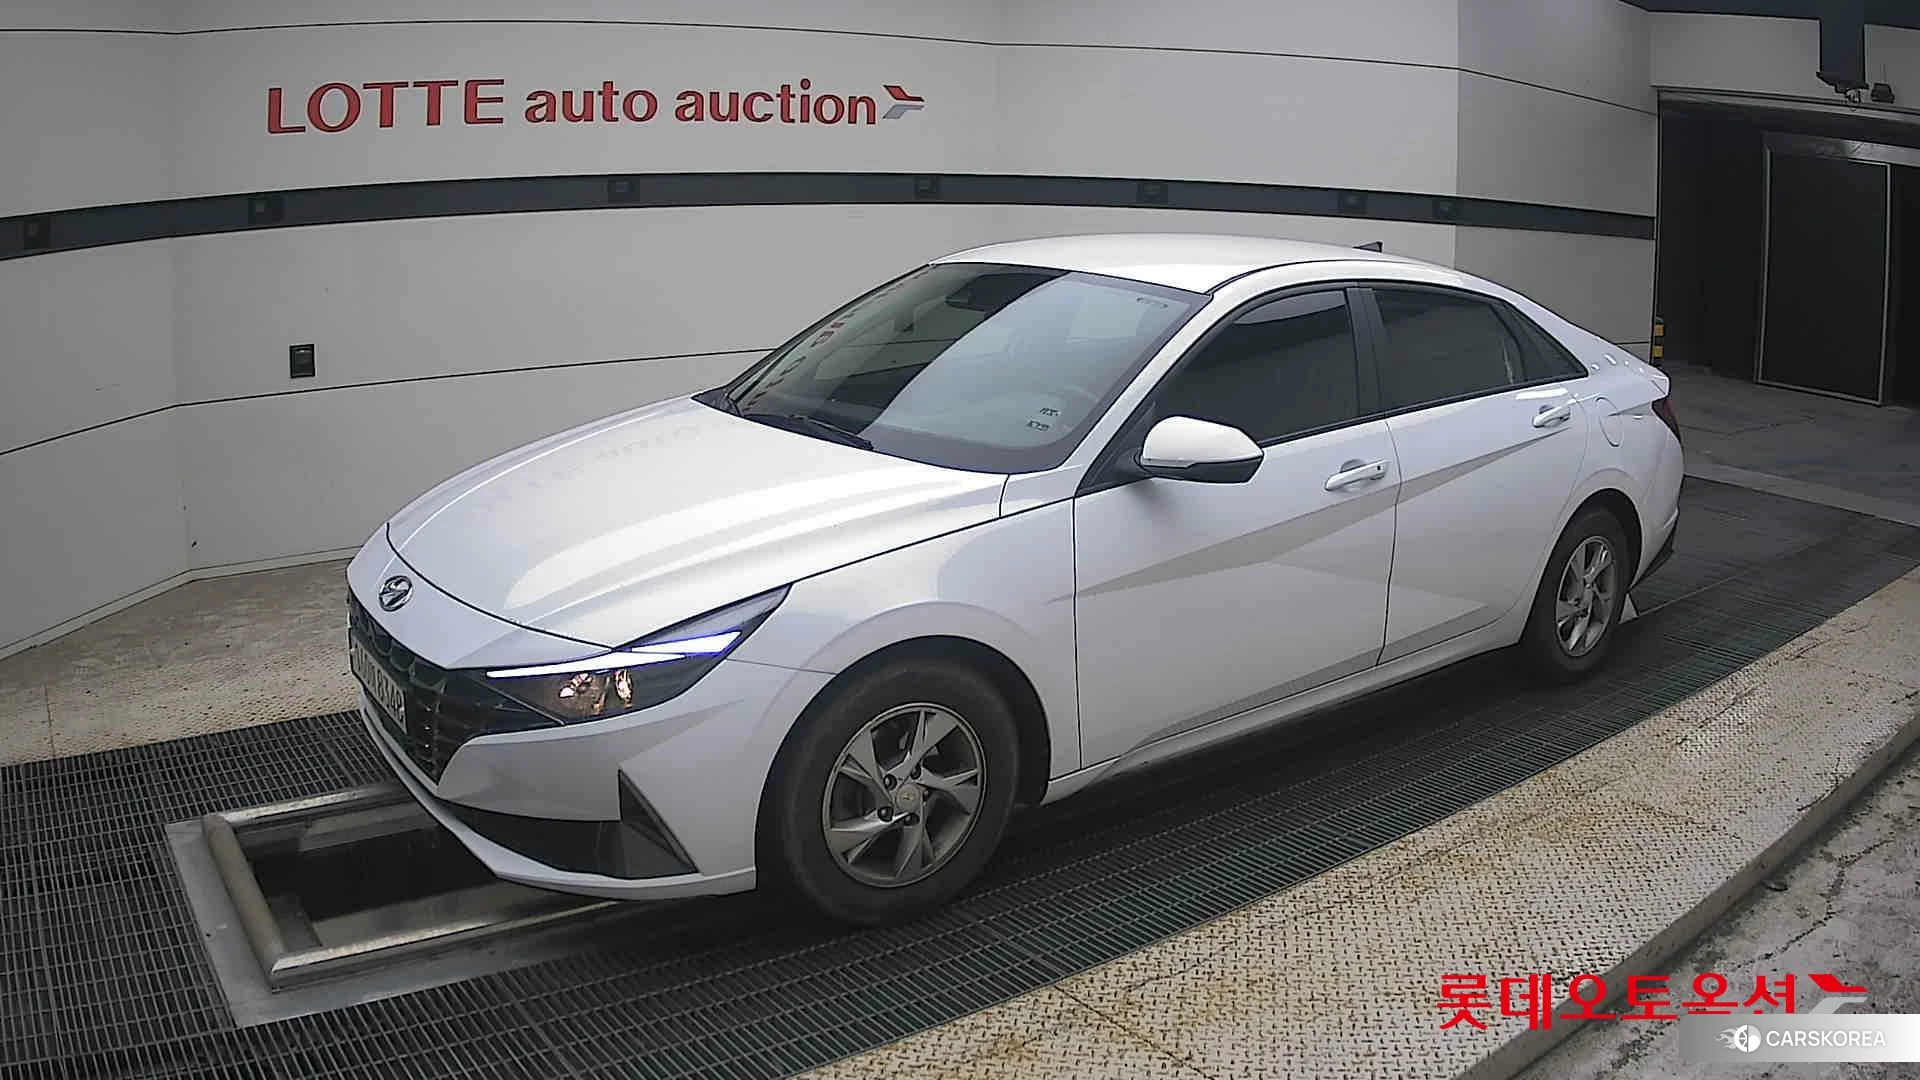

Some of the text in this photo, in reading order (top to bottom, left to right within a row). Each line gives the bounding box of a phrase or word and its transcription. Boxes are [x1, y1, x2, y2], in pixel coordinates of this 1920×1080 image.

[267, 78, 878, 135] LOTTE auto auction
